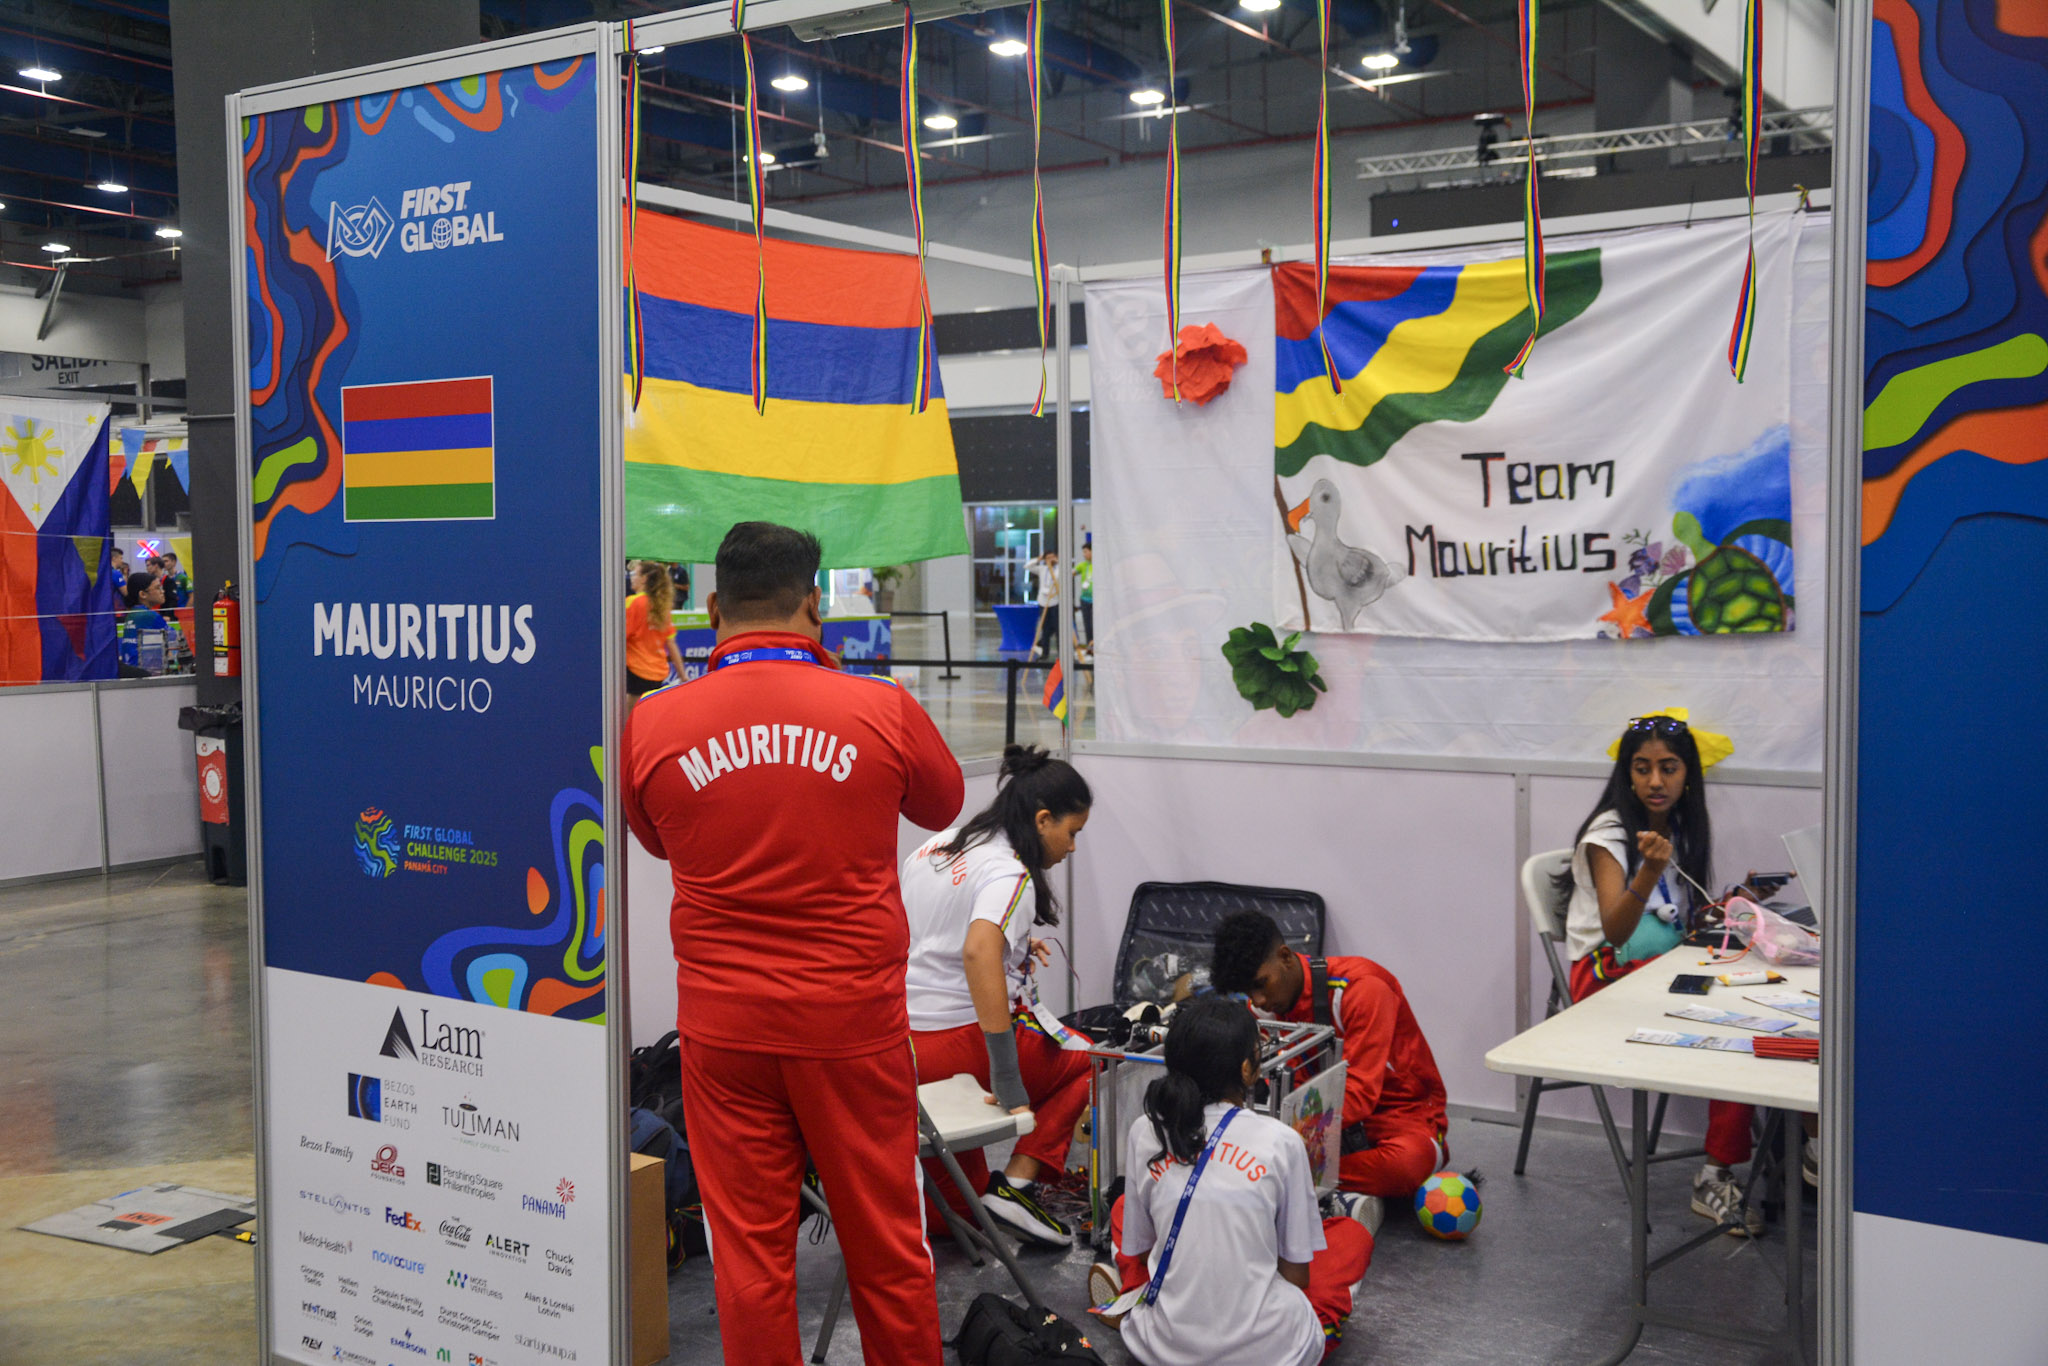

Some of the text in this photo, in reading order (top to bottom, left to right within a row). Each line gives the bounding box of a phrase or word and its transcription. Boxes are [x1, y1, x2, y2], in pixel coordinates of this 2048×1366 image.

[400, 181, 472, 219] FIRST
[400, 211, 504, 253] GLOBAL
[58, 371, 80, 385] EXIT
[1461, 452, 1615, 507] Team
[1405, 525, 1616, 578] Mauritius
[312, 602, 537, 664] MAURITIUS
[353, 674, 492, 714] MAURICIO
[678, 723, 858, 792] MAURITIUS
[404, 825, 474, 846] FIRST GLOBAL
[407, 842, 498, 867] CHALLENGE 2025
[432, 864, 448, 875] CITY
[420, 1009, 483, 1060] Lam
[421, 1052, 484, 1077] RESEARCH
[384, 1079, 416, 1096] BEZOS
[384, 1097, 418, 1114] EARTH
[384, 1115, 410, 1130] FUND
[300, 1136, 354, 1163] Bezos Family
[299, 1190, 371, 1216] STELLANTIS
[443, 1180, 496, 1201] Philanthropies
[385, 1206, 422, 1233] FedEx
[485, 1233, 530, 1257] ALERT
[545, 1248, 575, 1265] Chuck
[372, 1249, 425, 1274] novocure
[547, 1261, 572, 1277] Davis
[524, 1291, 541, 1304] Alan
[542, 1296, 548, 1306] &
[390, 1337, 427, 1355] EMERSON
